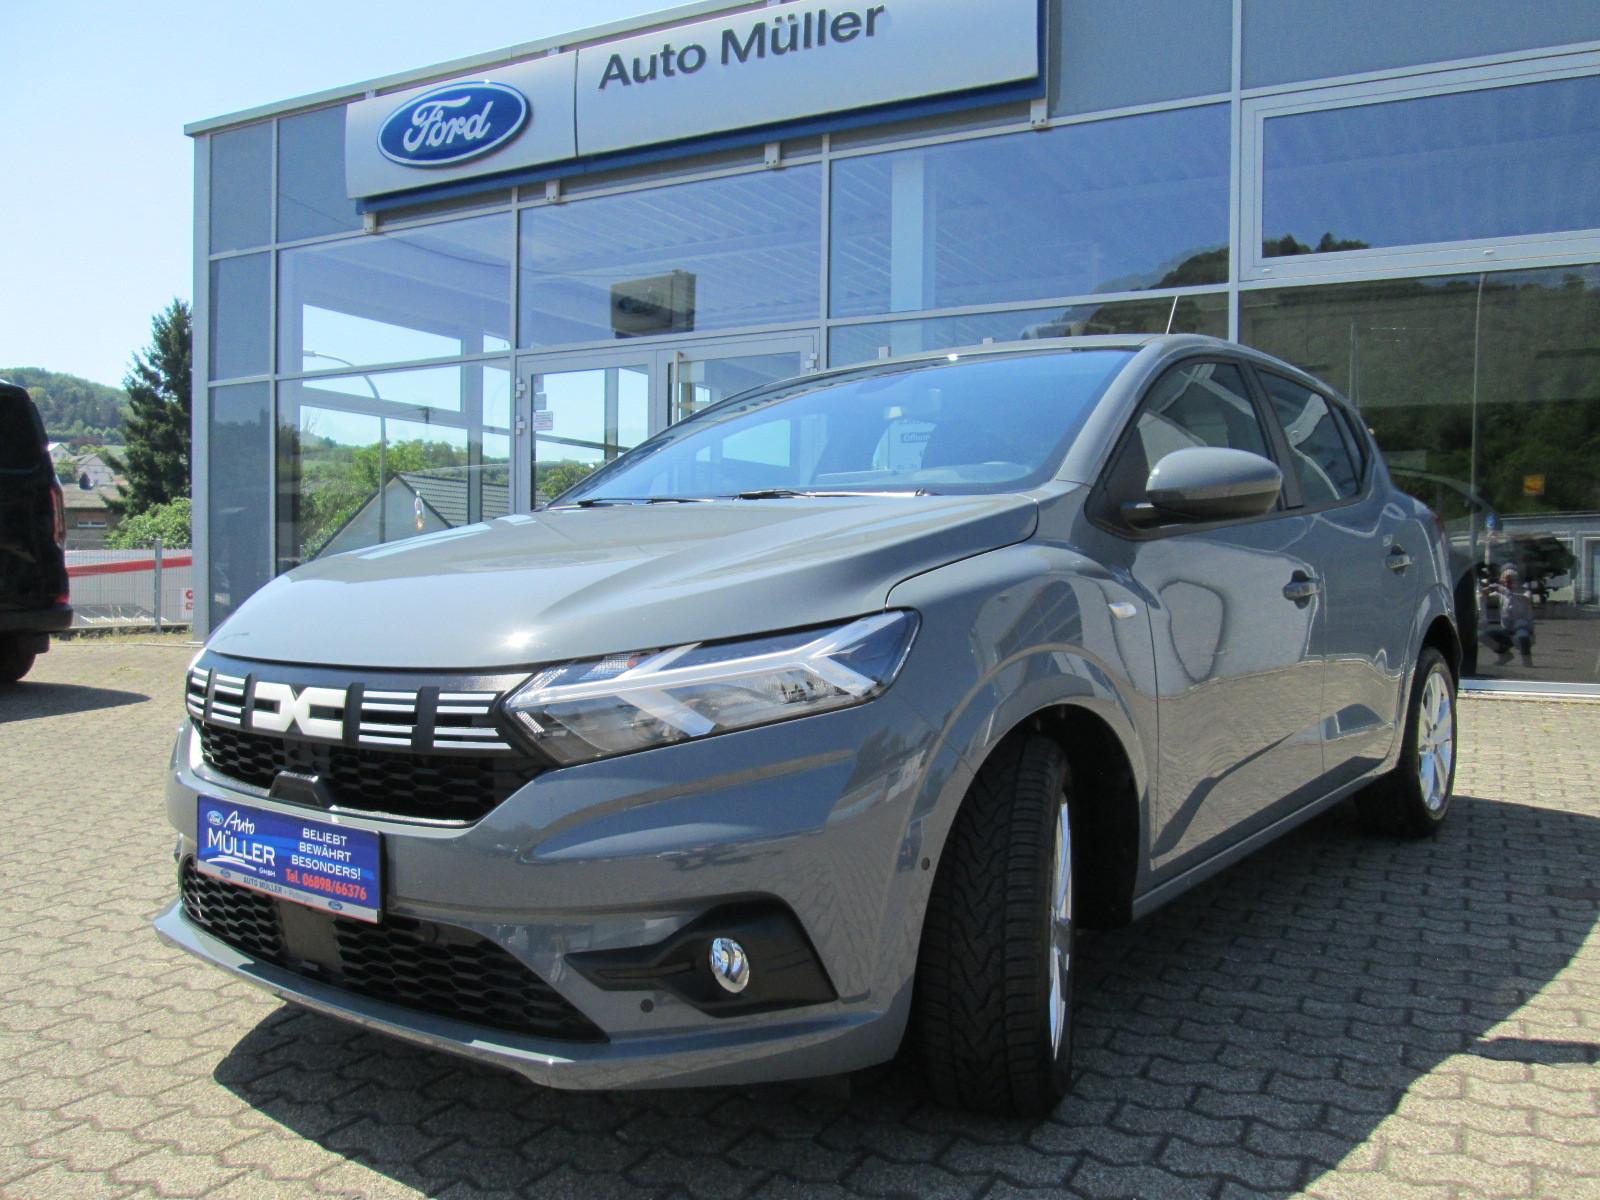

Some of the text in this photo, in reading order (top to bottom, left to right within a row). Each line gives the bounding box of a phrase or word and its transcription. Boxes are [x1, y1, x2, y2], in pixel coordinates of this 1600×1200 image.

[598, 4, 885, 90] Auto Müller
[403, 95, 494, 151] Ford
[223, 810, 255, 835] Auto
[302, 827, 347, 847] BELIEBT
[208, 827, 275, 866] MÜLLER
[299, 841, 351, 863] BEWÄHRT
[291, 854, 361, 880] BESONDERS!
[285, 867, 300, 884] Tel.
[302, 872, 367, 901] 06898/66376
